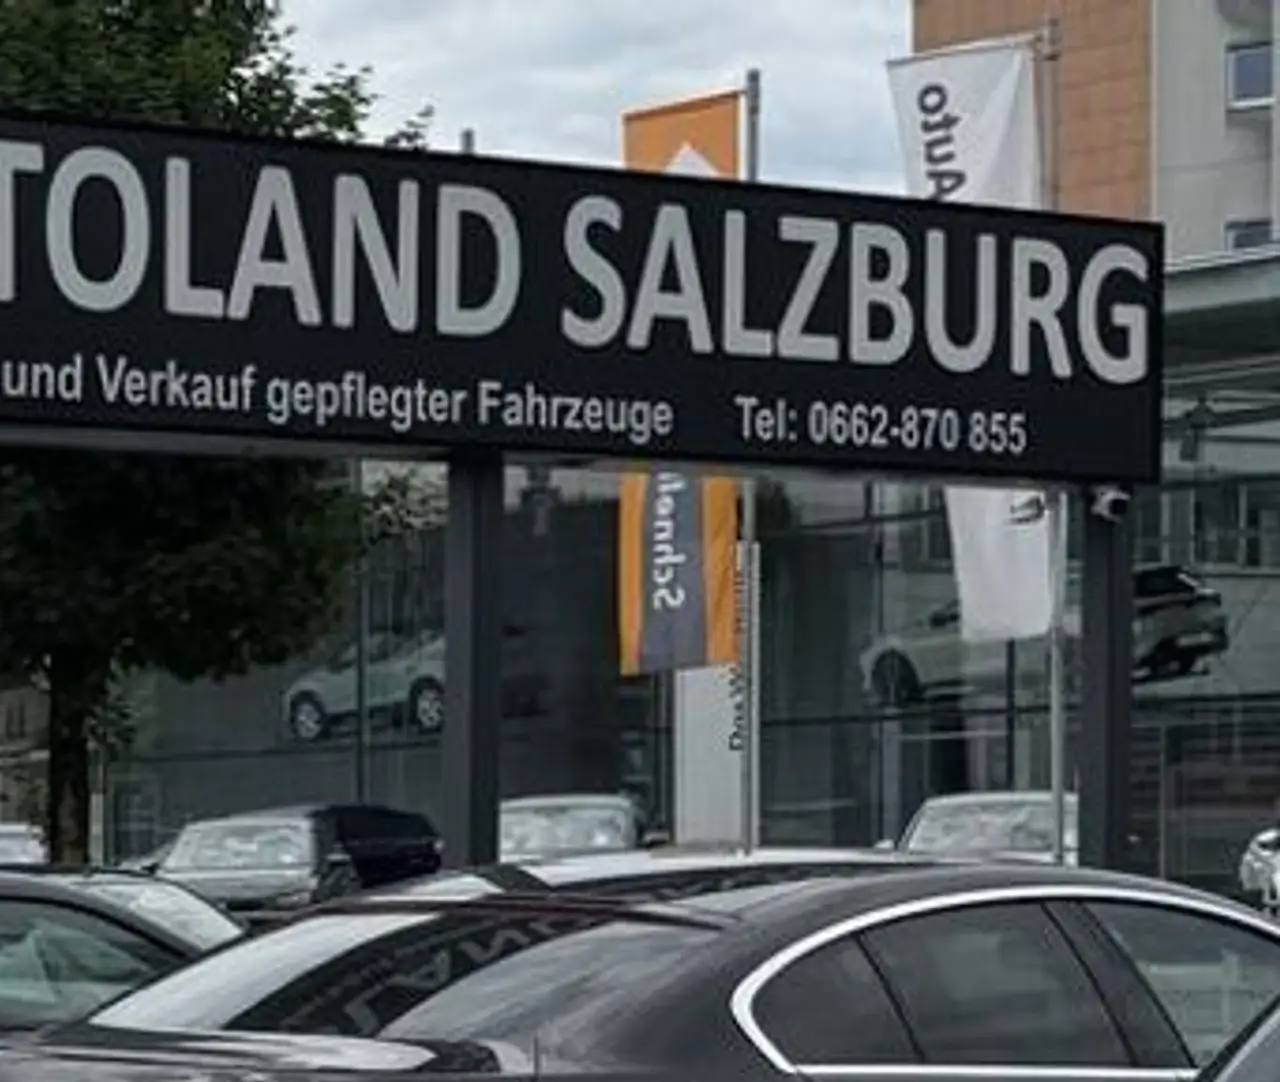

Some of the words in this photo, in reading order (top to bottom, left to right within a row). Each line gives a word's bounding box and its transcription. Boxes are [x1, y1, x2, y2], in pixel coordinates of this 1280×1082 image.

[561, 195, 1149, 384] SALZBURG
[1, 353, 83, 402] und
[96, 353, 256, 412] Verkauf
[266, 371, 467, 432] gepflegter
[477, 381, 674, 444] Fahrzeuge
[735, 395, 798, 443] Tel:
[808, 401, 959, 450] 0662-870
[968, 411, 1027, 454] 855
